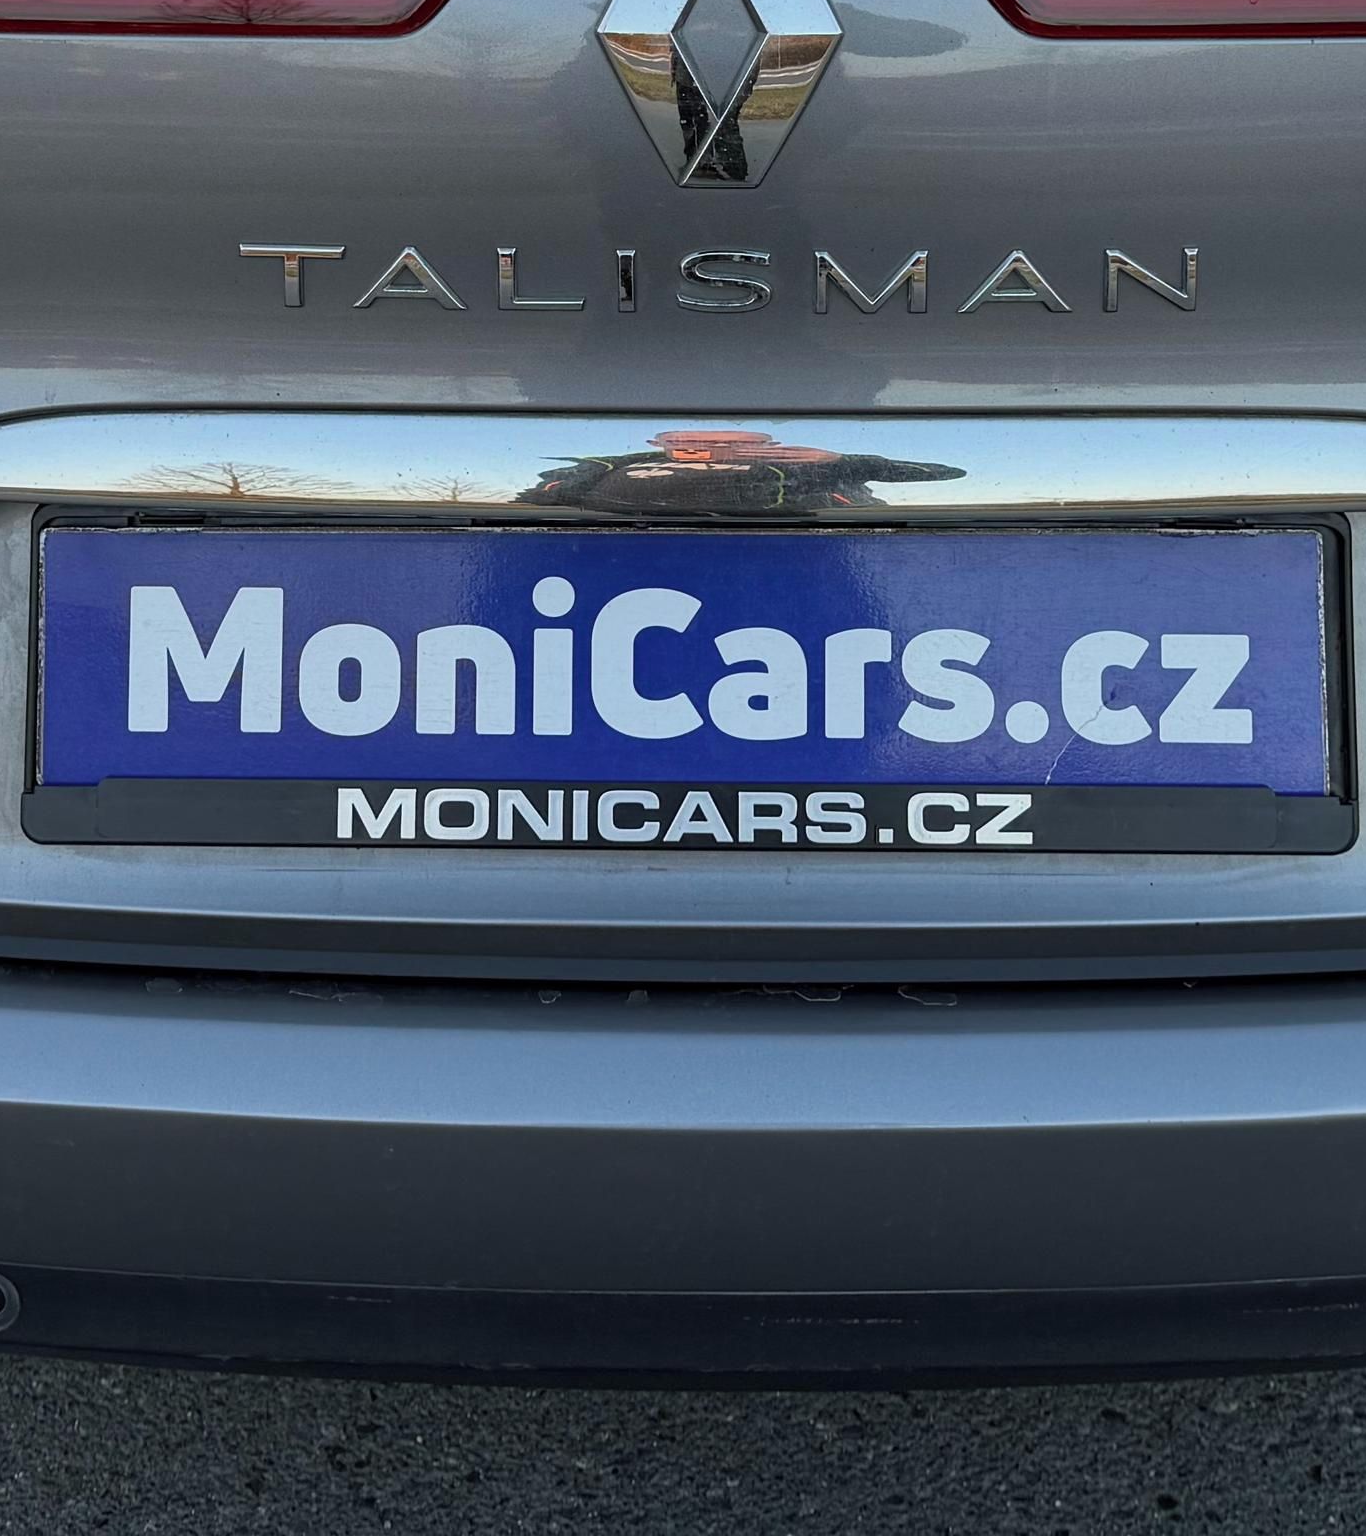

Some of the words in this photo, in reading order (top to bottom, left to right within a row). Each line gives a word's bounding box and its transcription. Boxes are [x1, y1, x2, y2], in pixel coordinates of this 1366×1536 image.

[237, 243, 1199, 315] TALISMAN
[126, 575, 1255, 746] MoniCars.cz
[335, 787, 1036, 848] MONICARS.CZ
